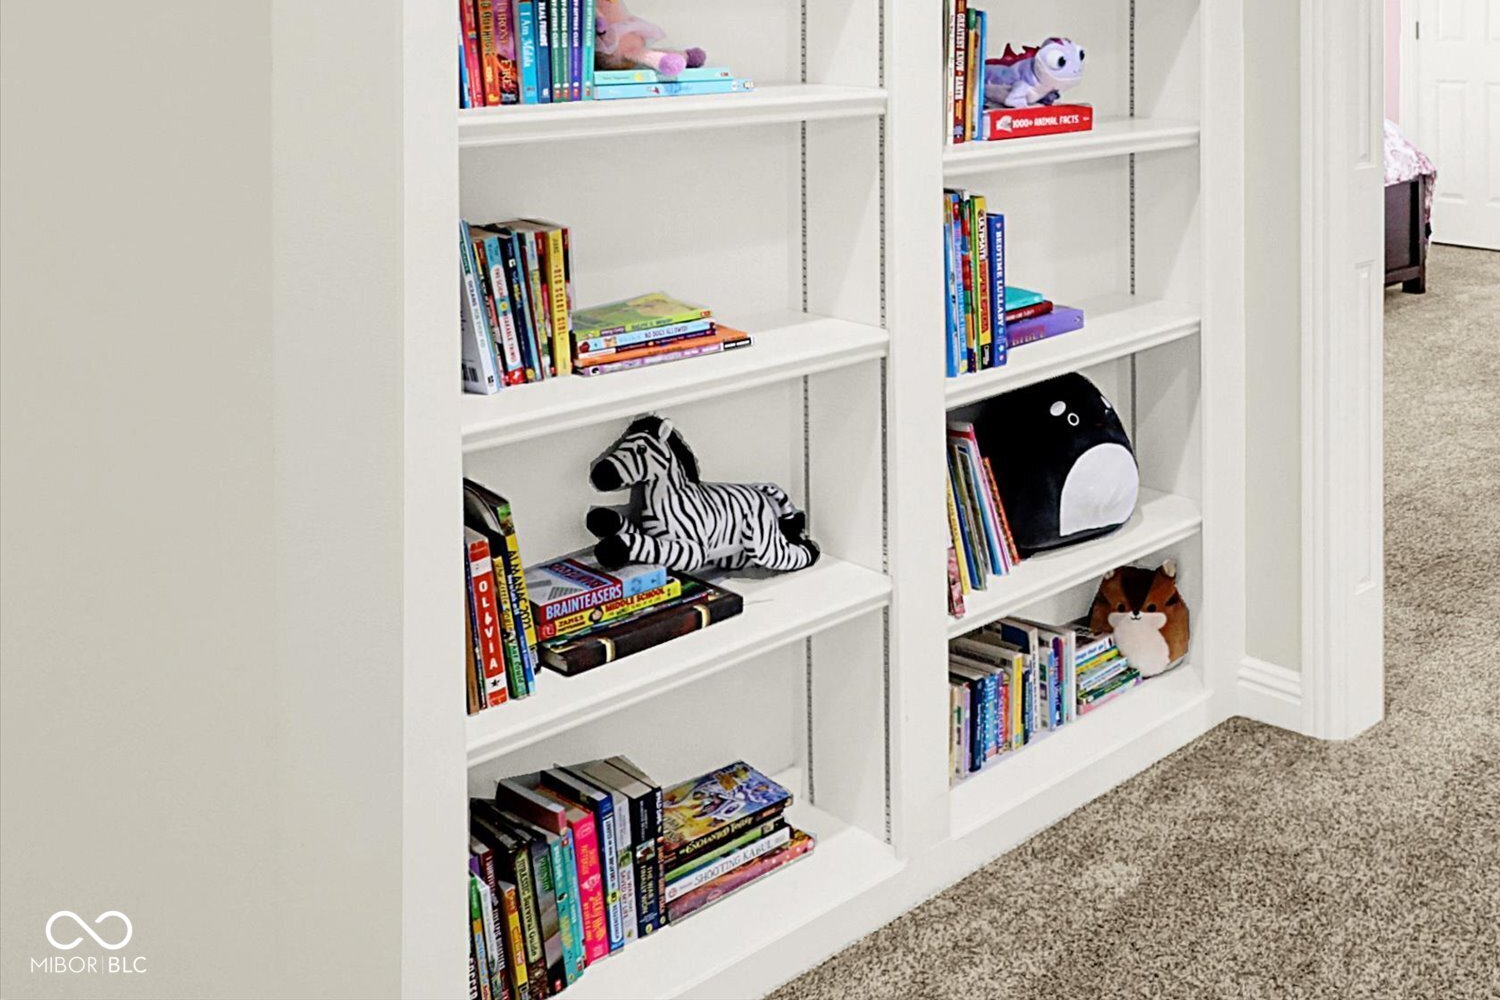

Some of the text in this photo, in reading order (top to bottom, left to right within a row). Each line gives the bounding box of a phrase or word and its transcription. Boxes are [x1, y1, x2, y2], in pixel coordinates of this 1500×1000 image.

[522, 20, 531, 35] Am
[522, 39, 534, 67] Malala
[955, 13, 965, 100] GREATEST KNOW EARTH
[1013, 115, 1079, 128] 1000+ ANIMAL FACTS
[978, 216, 986, 260] ULTIMATE
[507, 550, 531, 630] ALMANAC 2021
[546, 583, 623, 621] BRAINTEASERS
[605, 596, 635, 613] MIDDLE
[636, 587, 665, 603] SCHOOL
[477, 579, 499, 671] OLIVIA
[512, 661, 524, 684] Could
[694, 840, 771, 886] SHOOTING KABUL
[518, 858, 538, 957] JURASSIC Survival Guide
